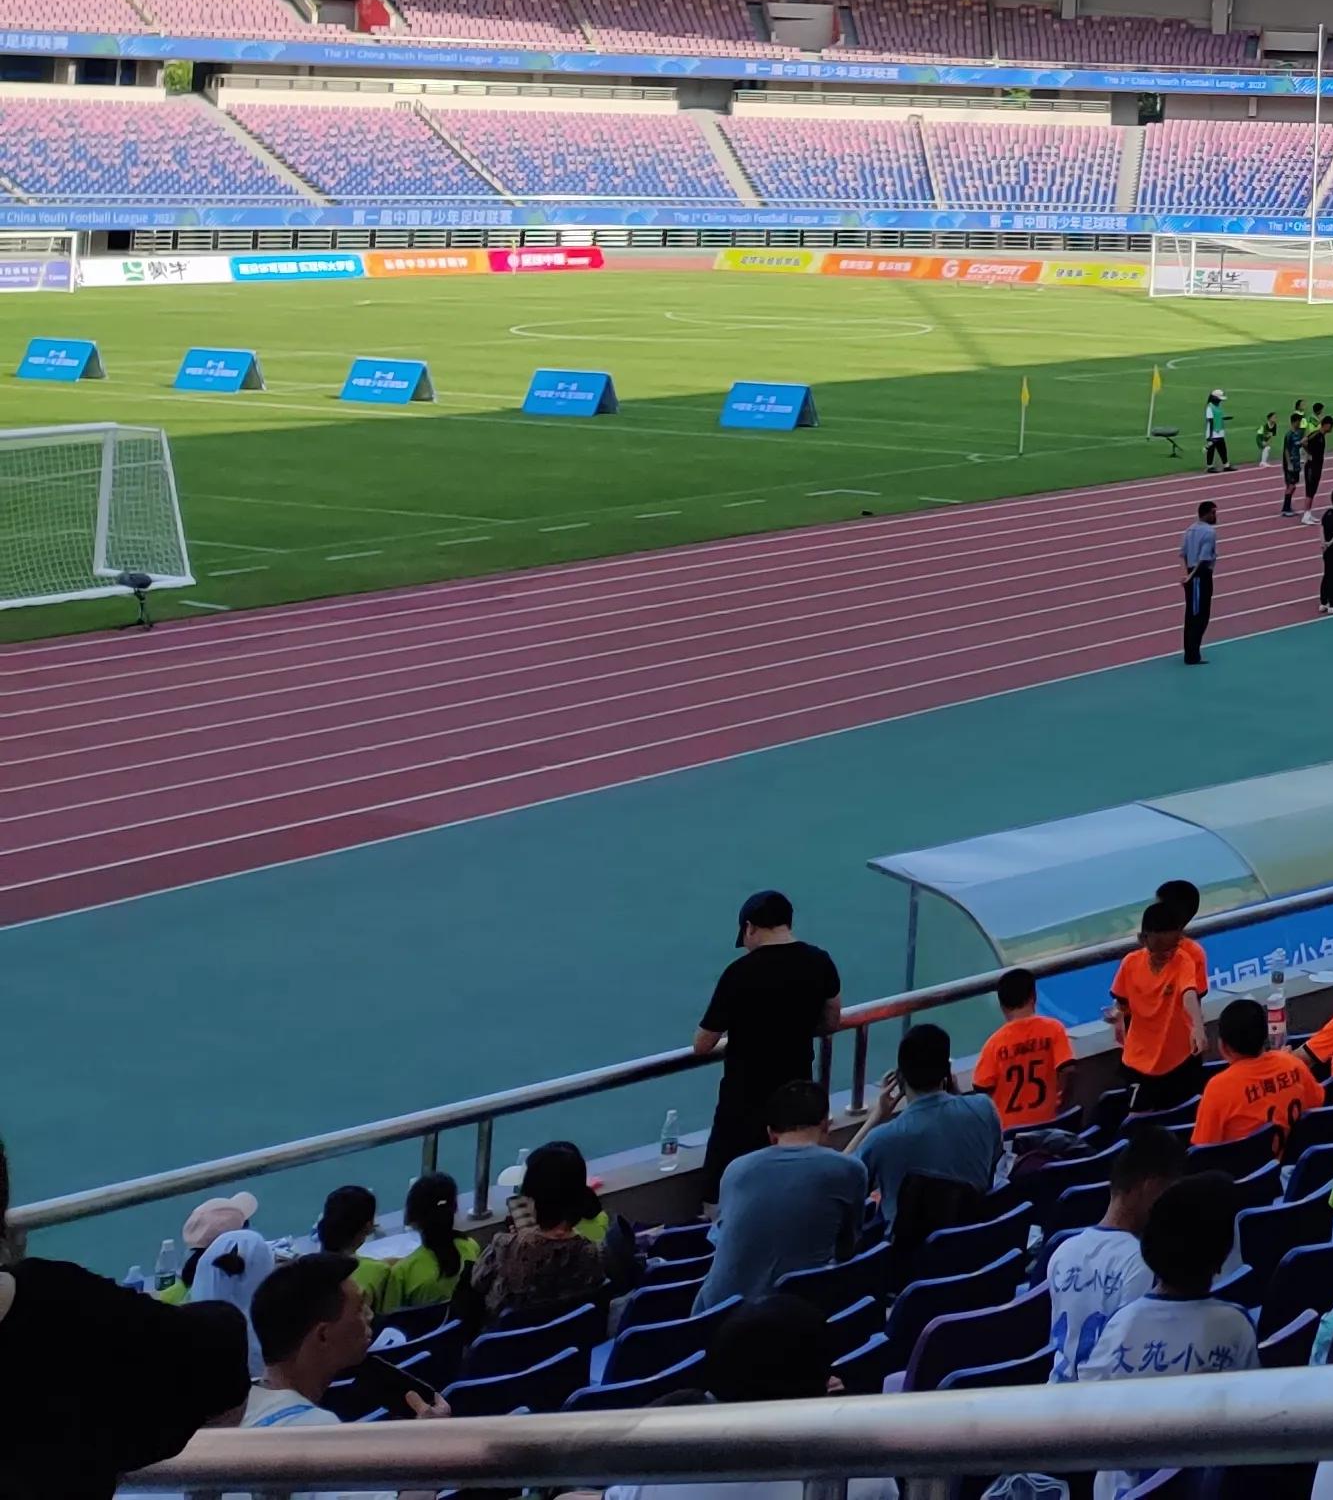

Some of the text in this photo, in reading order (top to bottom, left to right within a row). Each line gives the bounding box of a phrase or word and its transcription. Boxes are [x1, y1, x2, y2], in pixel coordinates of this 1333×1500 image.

[0, 34, 69, 50] 足球联赛
[745, 62, 898, 80] 第一届中国青少年足球联赛
[7, 212, 36, 223] China
[38, 213, 67, 223] Youth
[70, 212, 110, 224] Football
[113, 213, 149, 226] League
[353, 209, 513, 225] 第一届中国青少年足球联赛
[1005, 1060, 1047, 1114] 25
[1130, 1083, 1141, 1109] 7
[1111, 1339, 1239, 1374] 文苑小学
